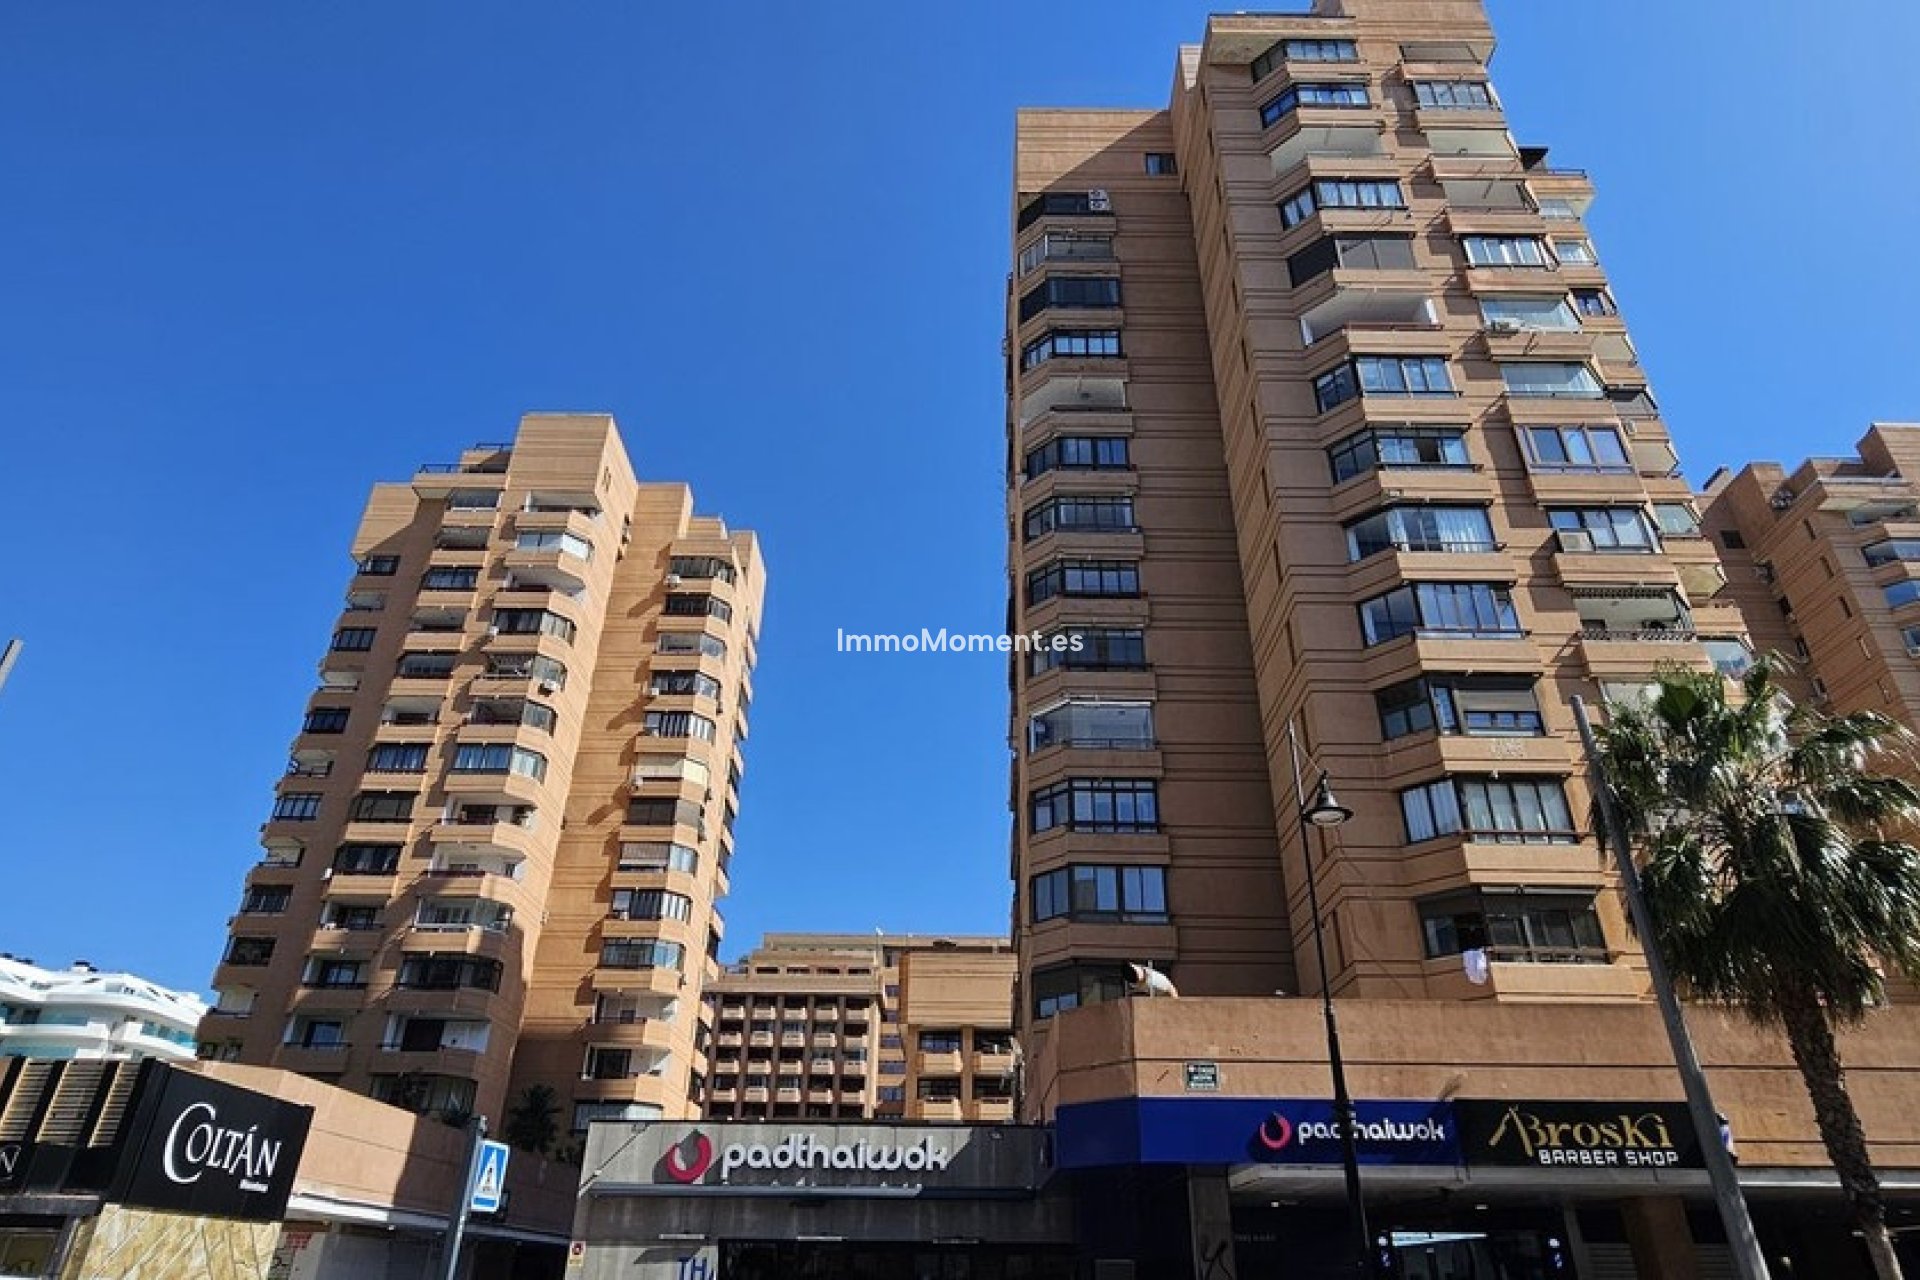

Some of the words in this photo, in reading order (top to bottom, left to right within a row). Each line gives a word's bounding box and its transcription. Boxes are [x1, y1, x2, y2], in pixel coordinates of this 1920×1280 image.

[721, 1133, 949, 1180] padthaiwok
[1538, 1149, 1618, 1166] BARBER
[1625, 1150, 1679, 1167] SHOP
